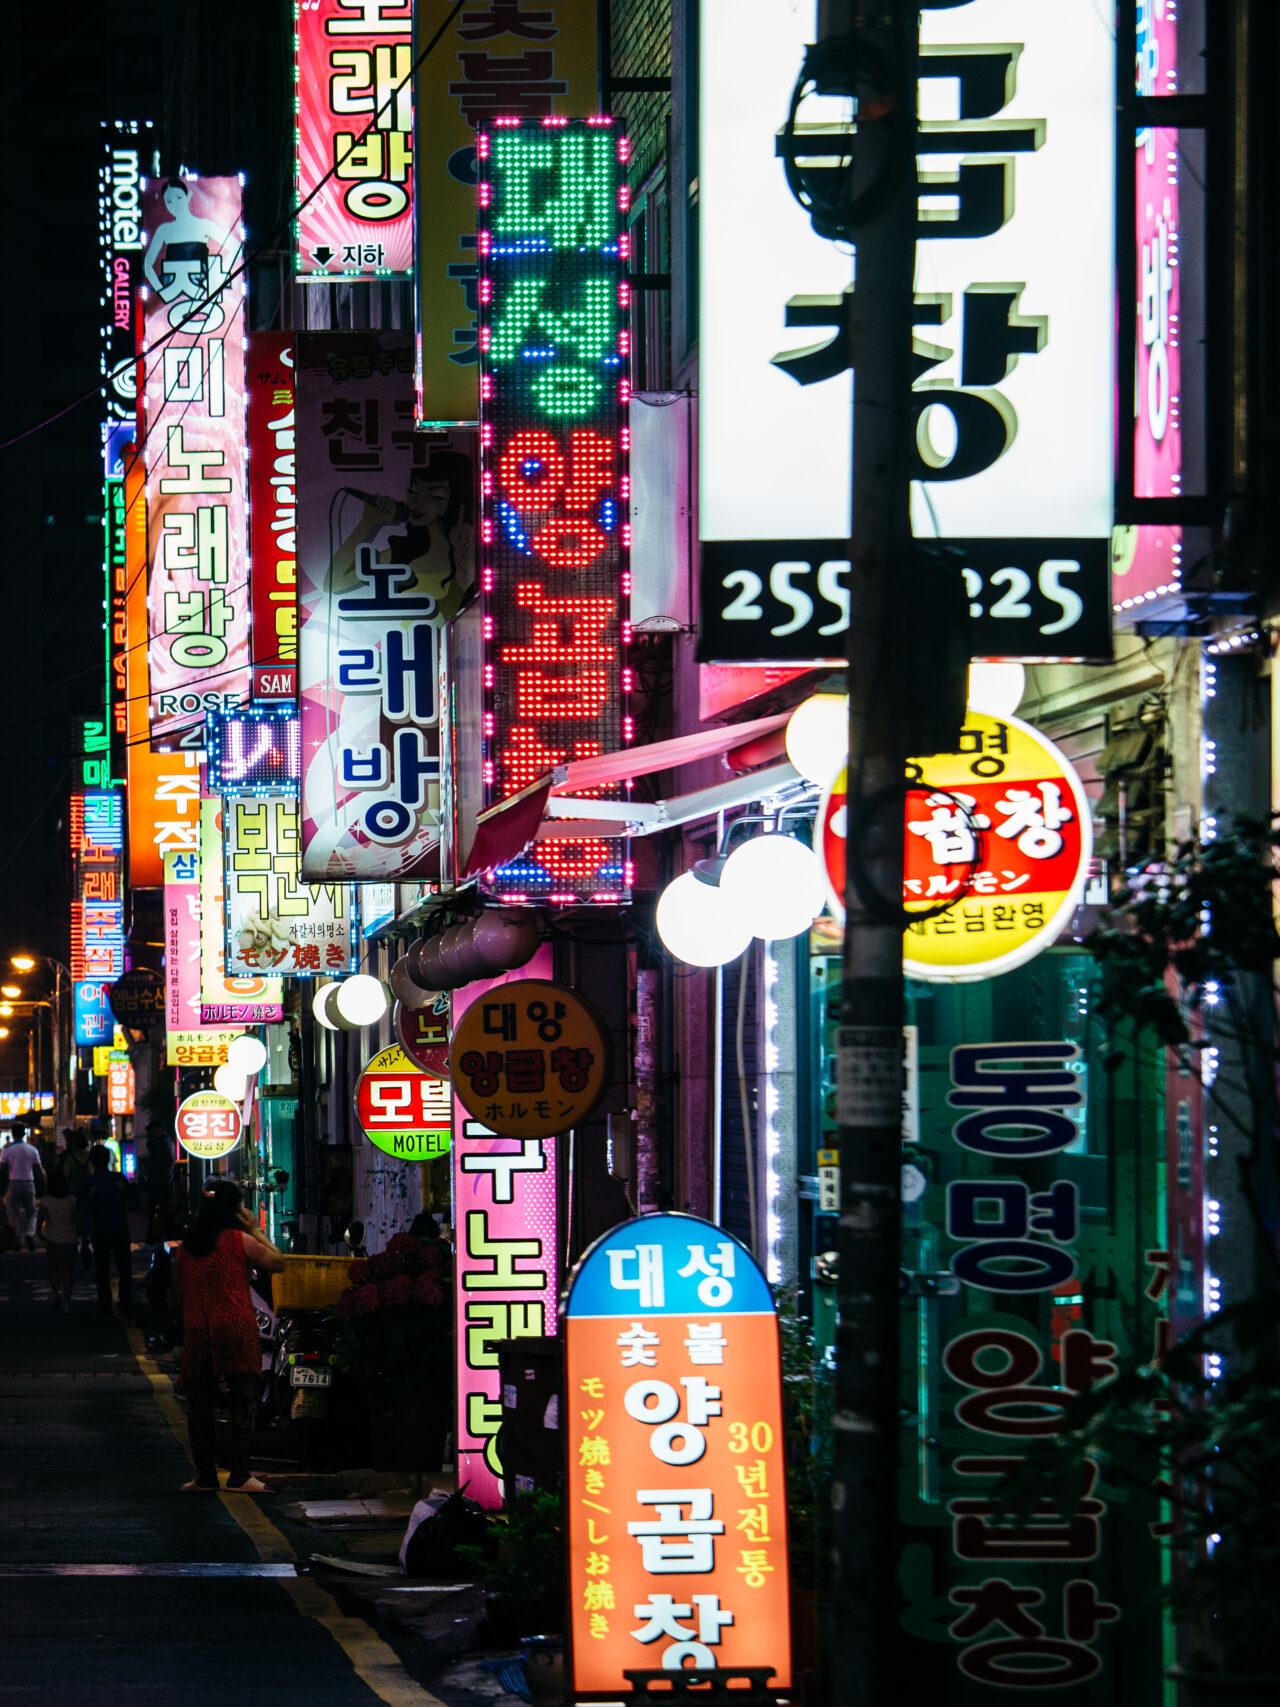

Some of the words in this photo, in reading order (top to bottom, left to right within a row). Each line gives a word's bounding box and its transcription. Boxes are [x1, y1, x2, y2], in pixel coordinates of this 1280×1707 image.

[113, 151, 142, 250] motel
[342, 243, 384, 266] 지하
[770, 2, 1048, 482] 곱창
[114, 257, 130, 331] GALLERY
[260, 673, 293, 694] SAM
[337, 541, 440, 832] 노래방
[158, 690, 242, 736] ROSE
[829, 780, 1073, 860] 곱창
[289, 923, 346, 939] 자갈치의명소
[235, 943, 346, 970] モツ焼き
[80, 983, 108, 1039] 여관
[415, 1013, 451, 1045] 노
[482, 1000, 568, 1042] 대양
[459, 1046, 595, 1097] 양곱창
[183, 1111, 235, 1138] 영진
[485, 1099, 577, 1122] ホルモン
[393, 1134, 447, 1153] MOTEL
[947, 1041, 1087, 1294] 동명
[605, 1242, 737, 1309] 대성
[616, 1321, 729, 1367] 숯불
[727, 1420, 776, 1590] 30년전통
[624, 1375, 735, 1686] 양곱창
